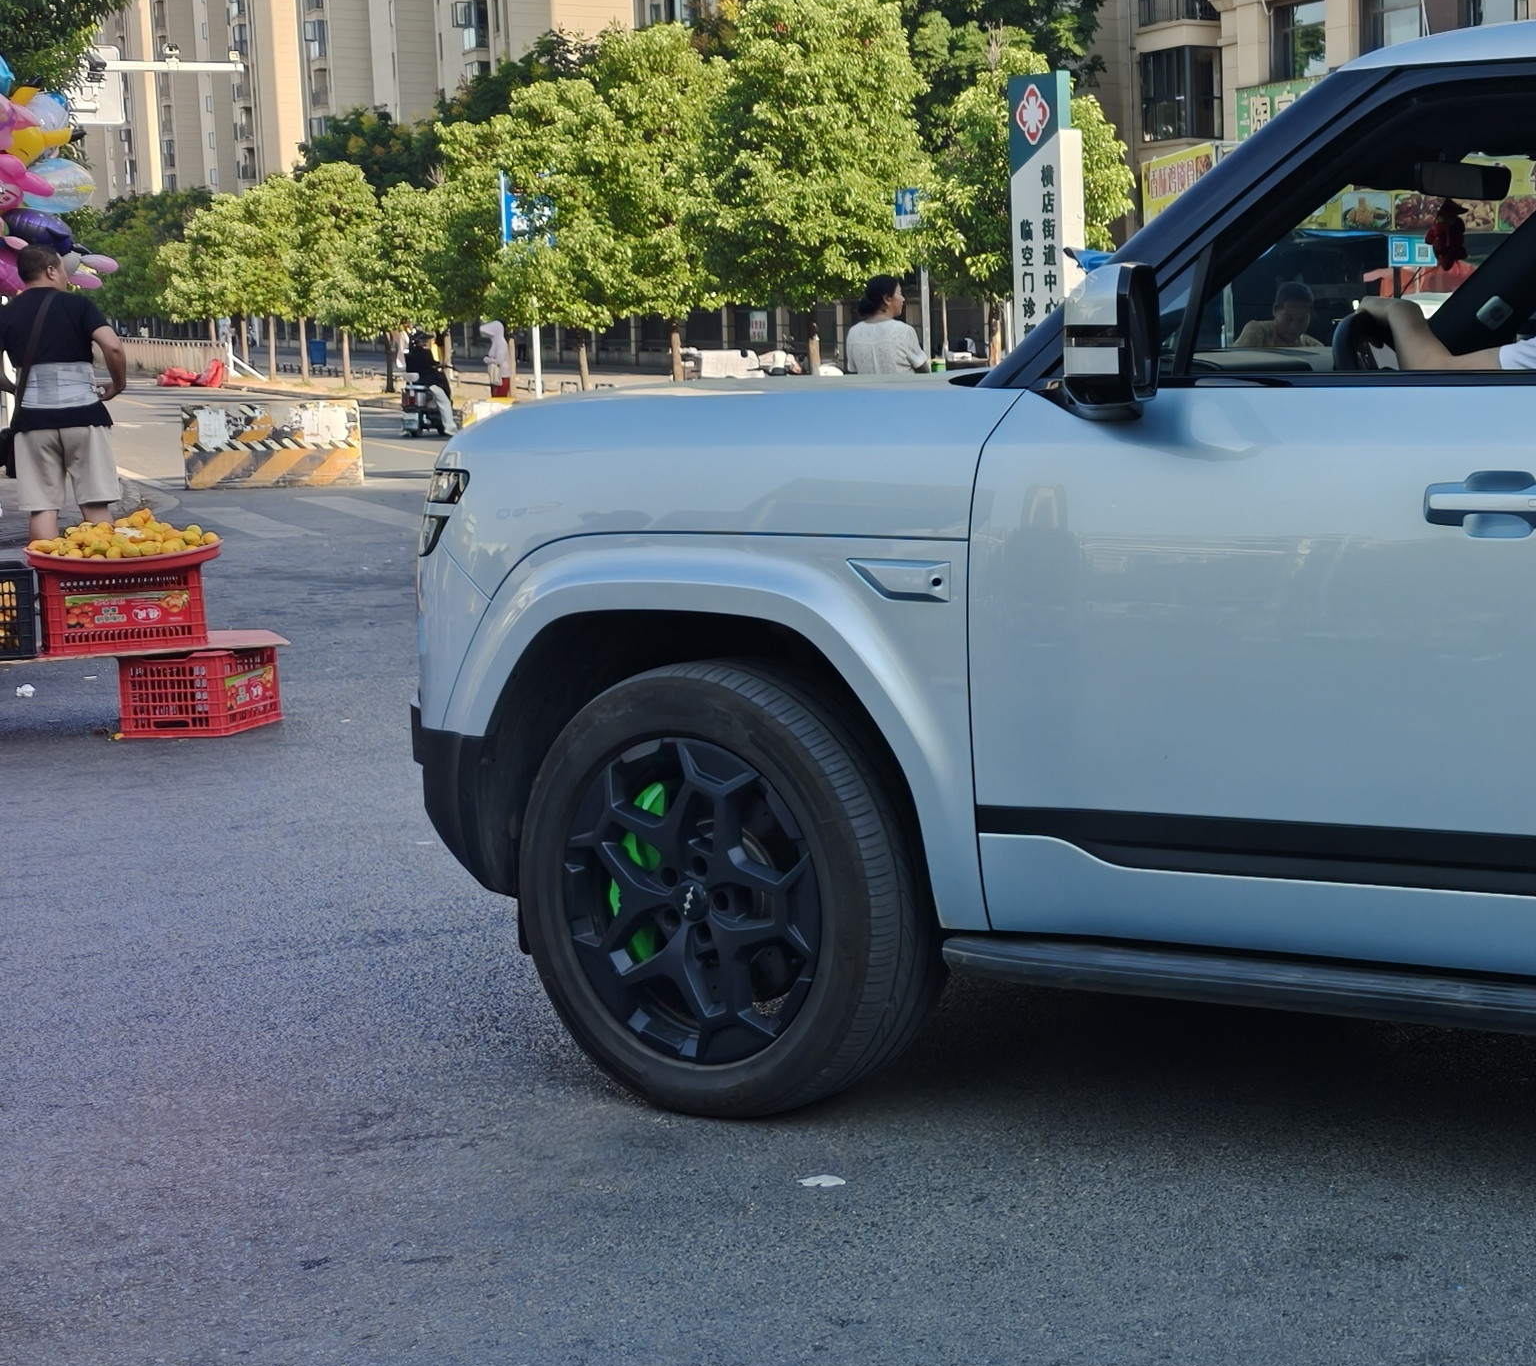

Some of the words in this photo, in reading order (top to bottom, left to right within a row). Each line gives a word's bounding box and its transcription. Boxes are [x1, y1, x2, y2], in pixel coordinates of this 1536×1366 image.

[1041, 164, 1058, 314] 横店街道中心
